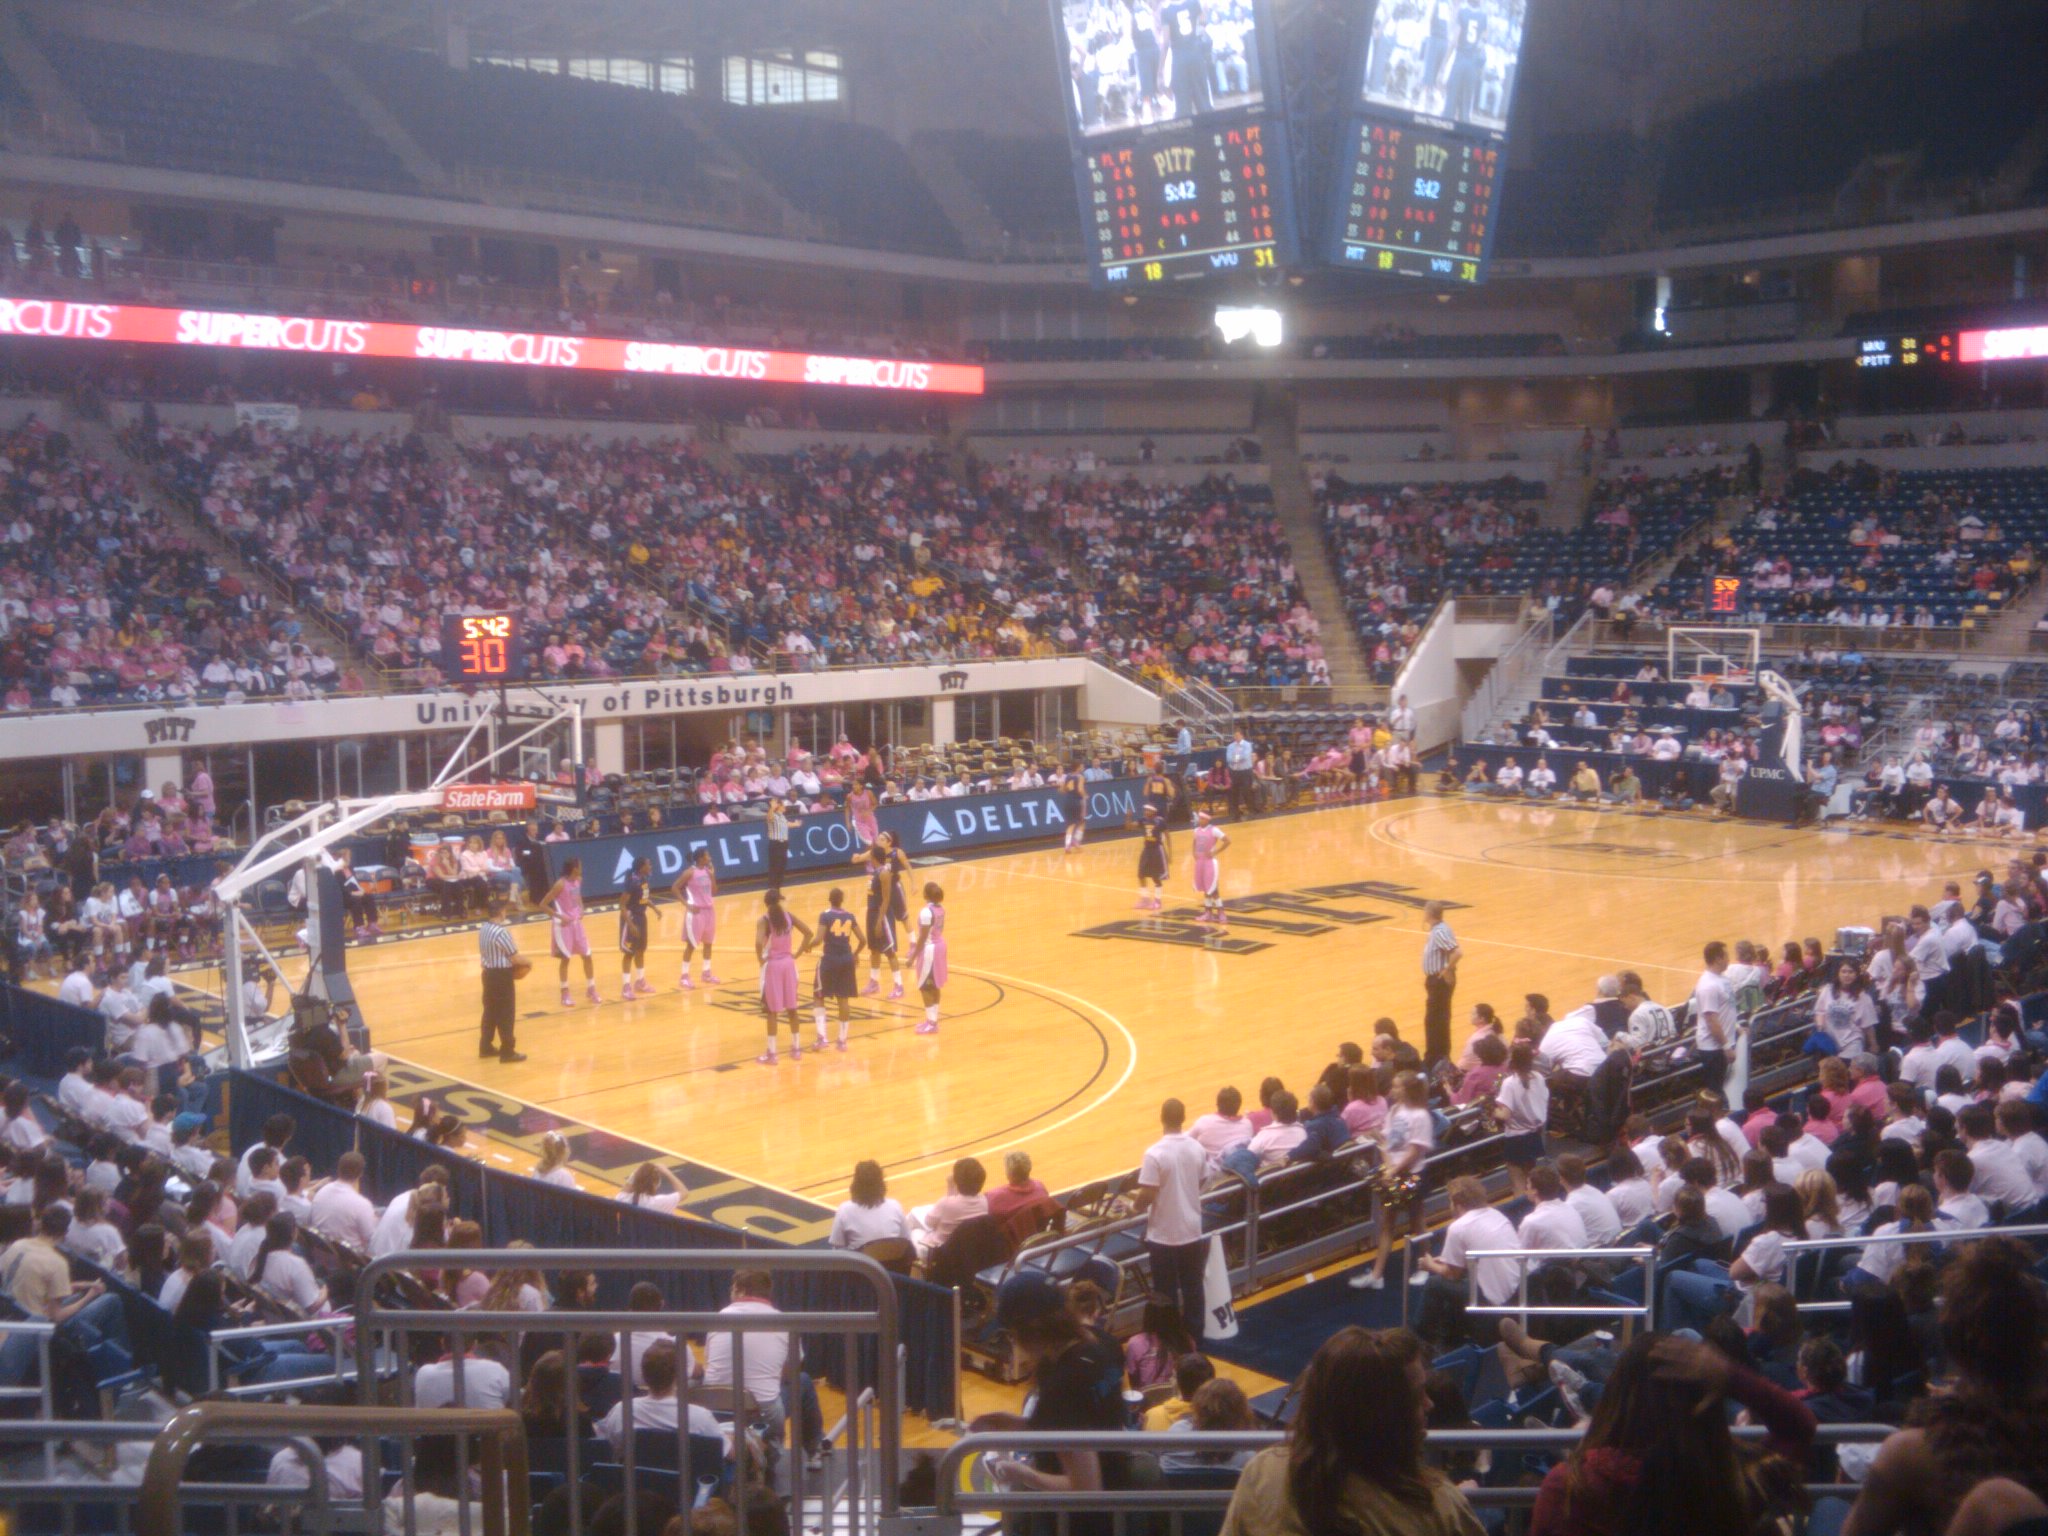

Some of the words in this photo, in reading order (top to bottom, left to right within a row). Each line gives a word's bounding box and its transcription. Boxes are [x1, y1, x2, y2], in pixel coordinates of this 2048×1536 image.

[1153, 146, 1196, 178] PITT
[1415, 144, 1449, 173] PITT
[1164, 180, 1197, 202] 5:42
[1414, 178, 1440, 199] 5:42
[1210, 251, 1238, 269] WVU
[1254, 247, 1274, 268] 31
[1345, 246, 1366, 261] PITT
[1379, 251, 1393, 270] 18
[1107, 266, 1129, 281] PITT
[1144, 261, 1163, 281] 18
[1431, 258, 1453, 273] WVU
[1461, 262, 1477, 283] 31
[177, 310, 366, 354] SUPERCUTS
[416, 325, 579, 367] SUPERCUTS
[624, 342, 768, 380] SUPERCUTS
[804, 355, 929, 390] SUPERCUTS
[1863, 354, 1892, 367] PITT
[1712, 591, 1736, 611] 30
[462, 616, 511, 639] 5:42
[459, 638, 507, 674] 30
[938, 671, 968, 691] PITT
[603, 692, 630, 712] of
[645, 681, 794, 710] Pittsburgh
[144, 717, 196, 744] PITT
[1750, 766, 1786, 780] UPMC
[830, 918, 852, 937] 44
[1067, 880, 1474, 956] PITT
